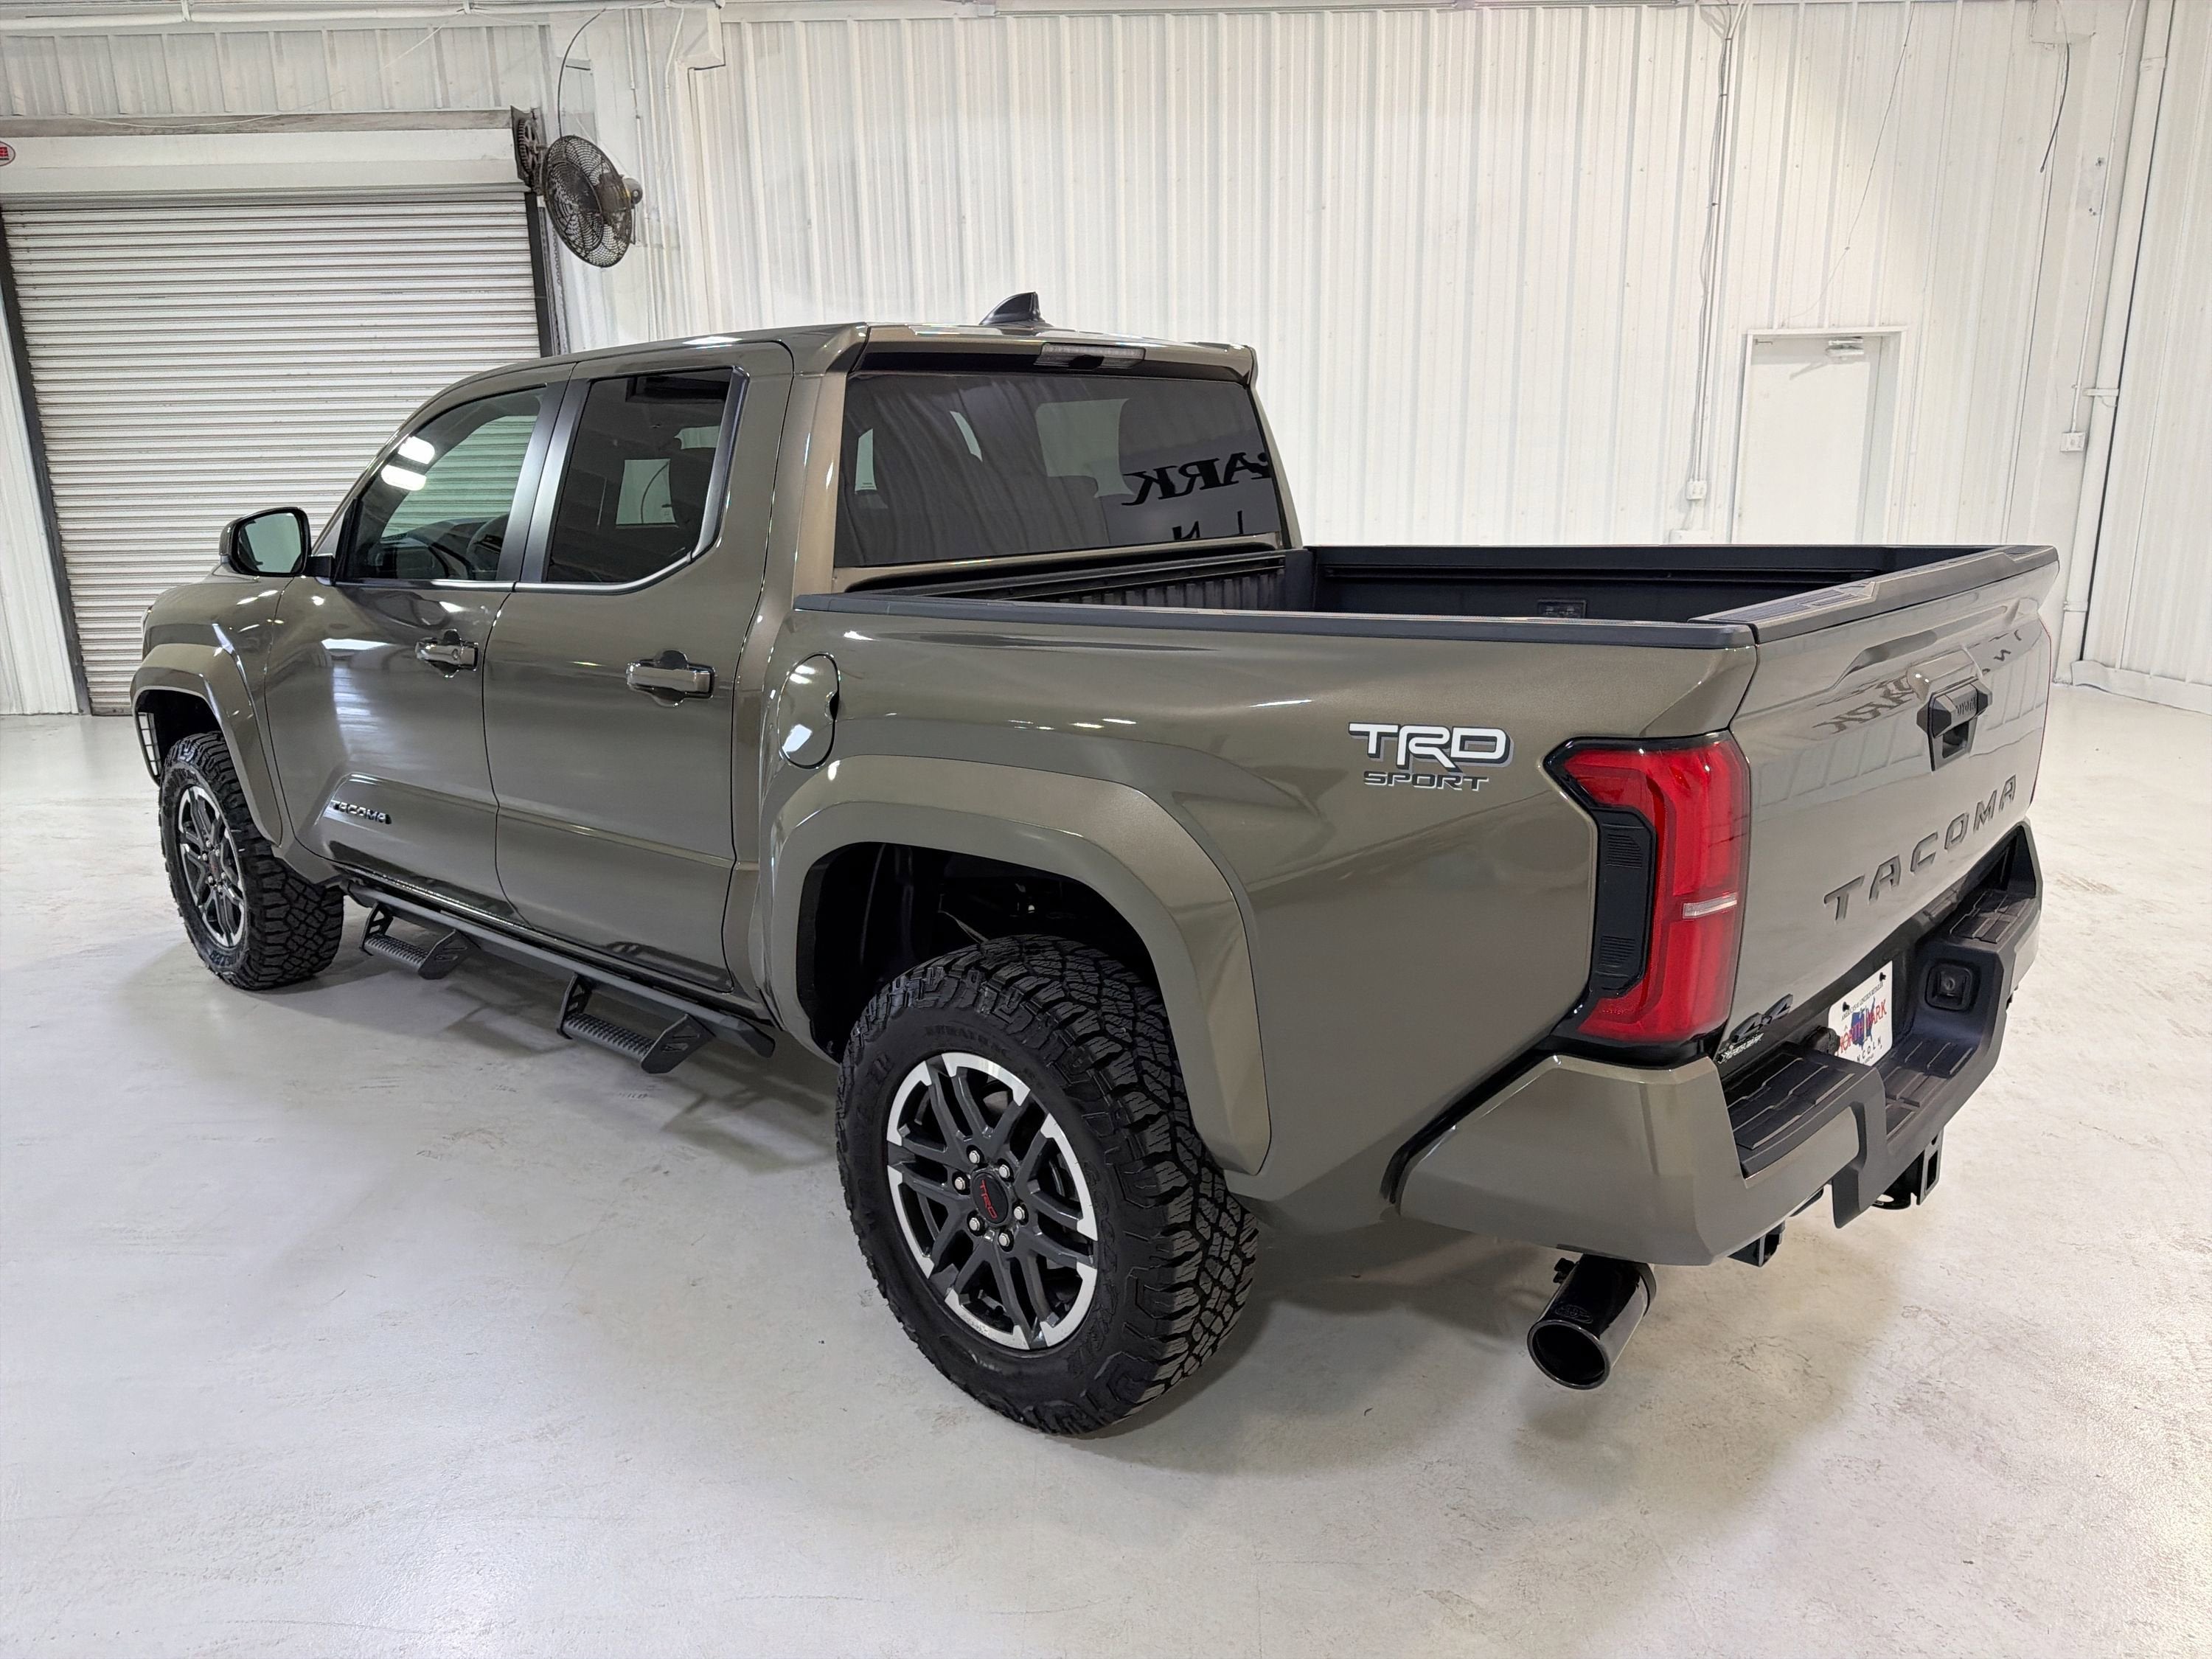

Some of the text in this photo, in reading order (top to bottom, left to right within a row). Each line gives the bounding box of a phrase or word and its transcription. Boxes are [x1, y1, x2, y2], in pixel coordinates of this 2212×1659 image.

[1347, 722, 1513, 774] TRD
[1363, 771, 1489, 791] SPORT
[1823, 774, 2017, 922] TACOMA
[1854, 1035, 1882, 1062] NCOLN
